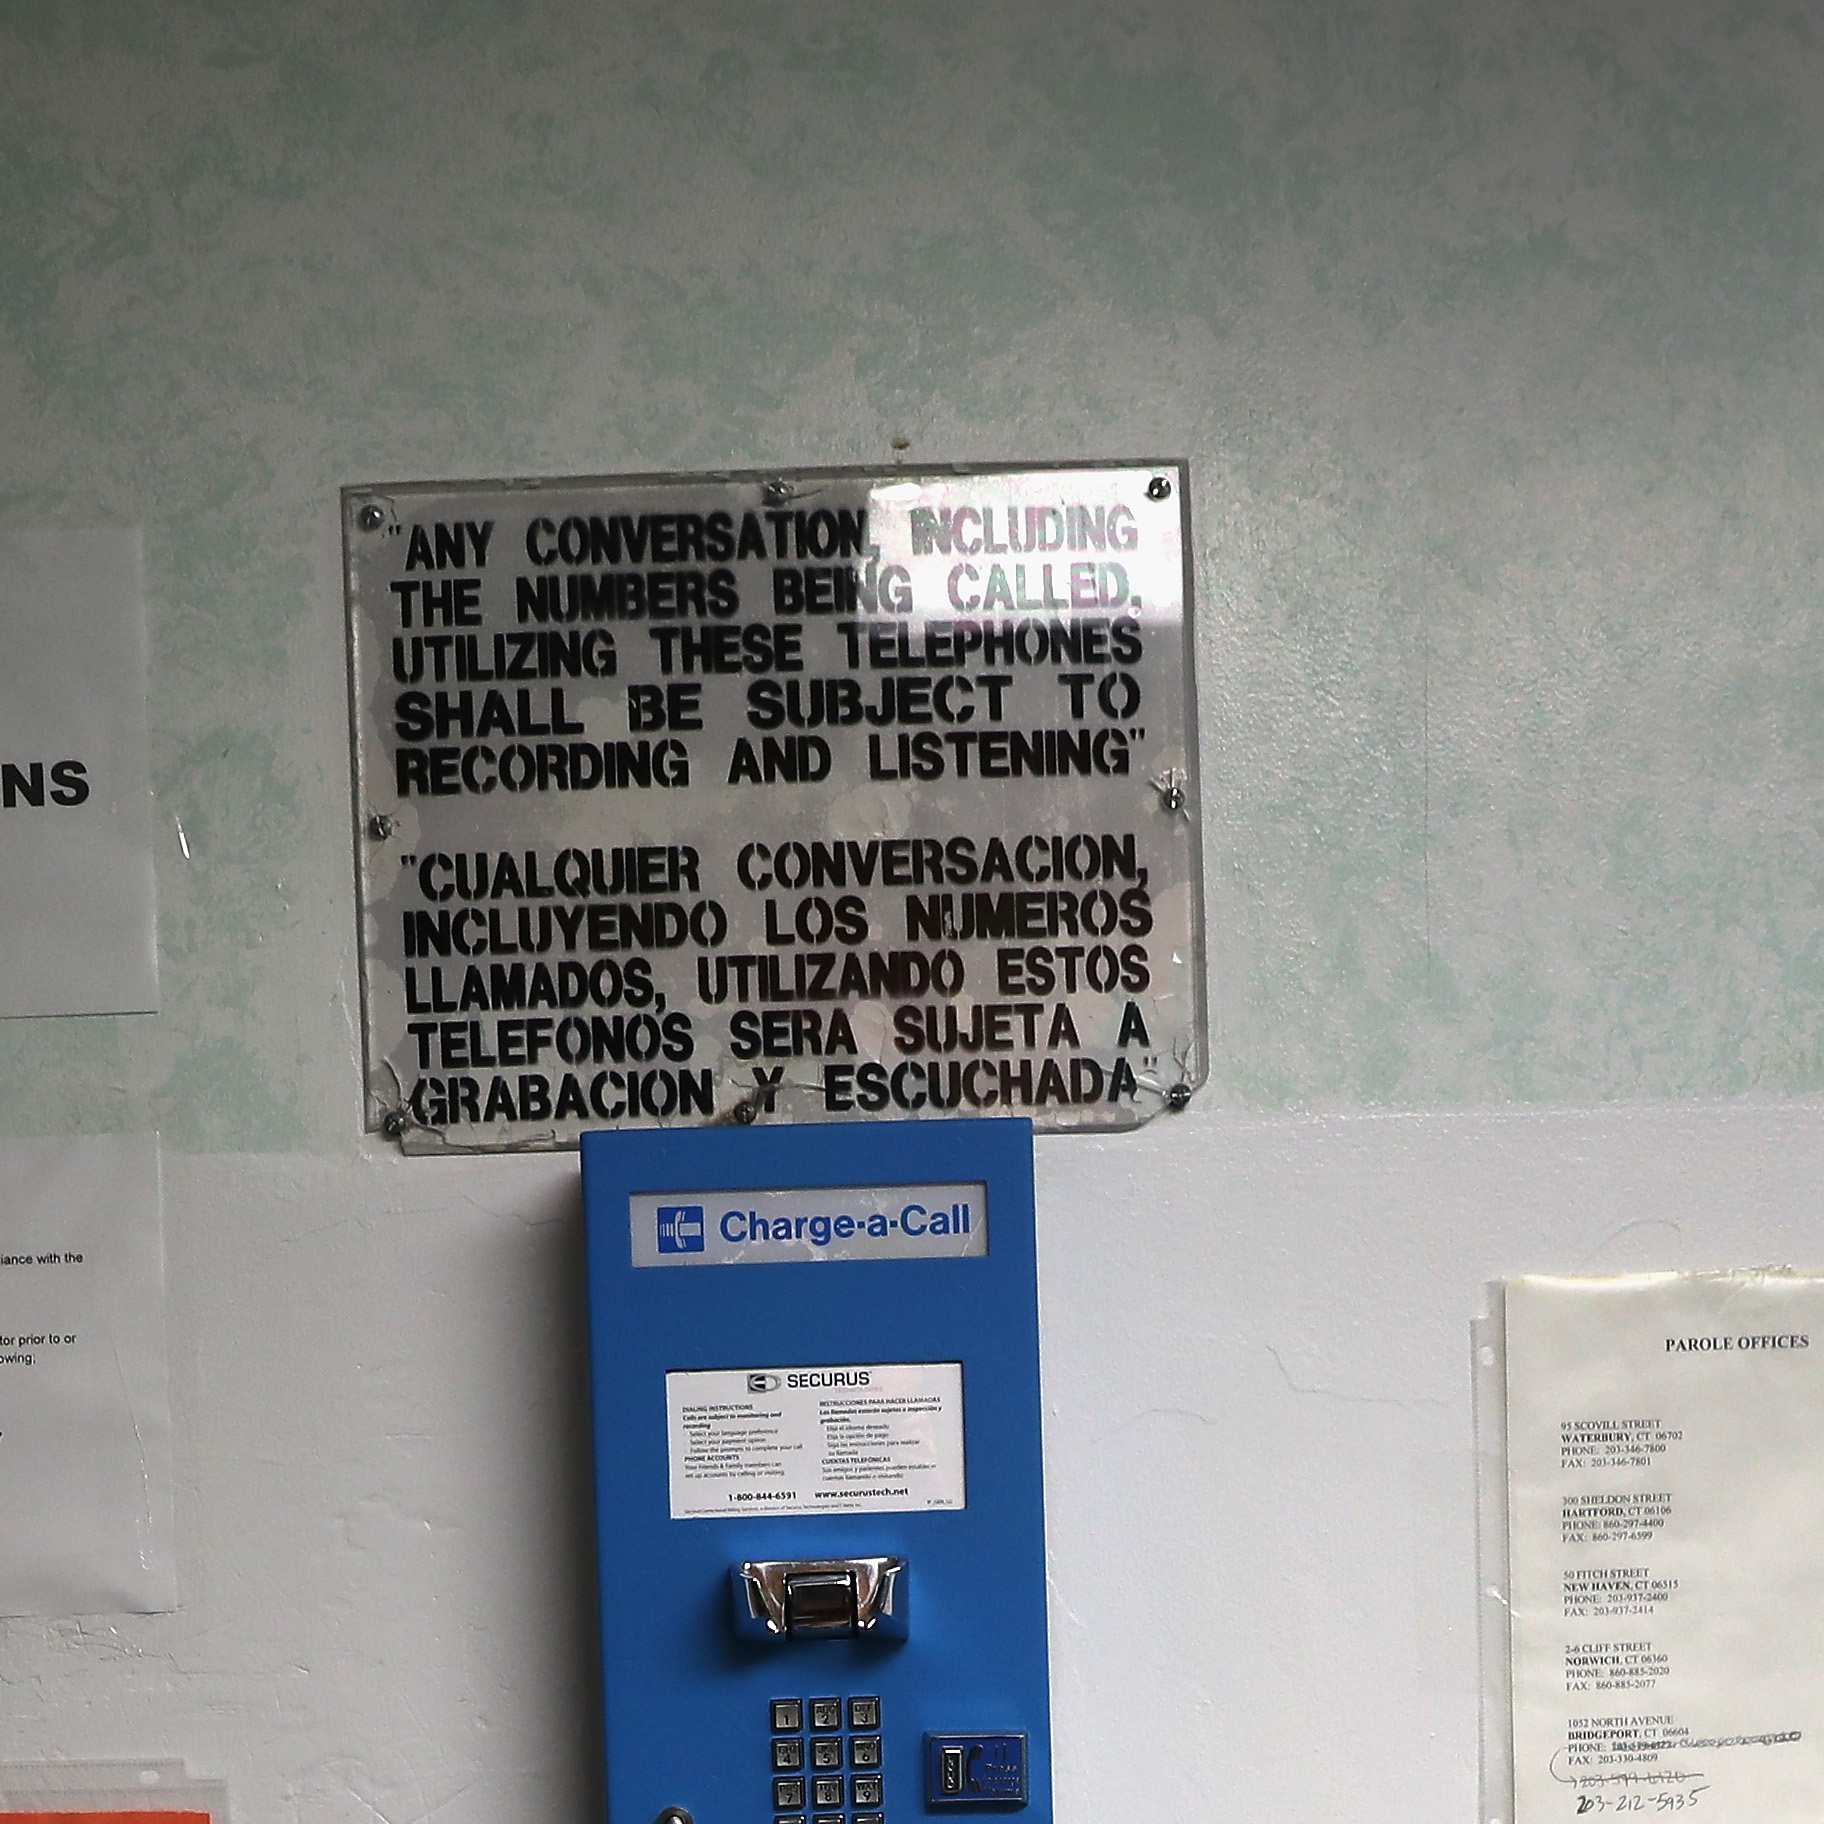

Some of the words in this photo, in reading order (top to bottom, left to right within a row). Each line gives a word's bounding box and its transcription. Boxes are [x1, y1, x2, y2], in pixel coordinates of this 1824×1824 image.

[388, 521, 494, 572] "ANY
[527, 508, 880, 568] CONVERSATION,
[907, 503, 1138, 556] INCLUDING
[390, 578, 482, 628] THE
[516, 568, 740, 624] NUMBERS
[774, 563, 913, 614] BEING
[947, 562, 1142, 614] CALLED,
[392, 628, 617, 684] UTILIZING
[649, 623, 804, 675] THESE
[839, 618, 1143, 670] TELEPHONES
[394, 687, 584, 742] SHALL
[628, 683, 703, 733] BE
[747, 675, 1013, 730] SUBJECT
[1058, 671, 1141, 720] TO
[395, 738, 689, 798] RECORDING
[728, 735, 831, 785] AND
[868, 725, 1145, 781] LISTENING"
[36, 1253, 61, 1264] with
[64, 1252, 83, 1263] the
[1666, 1337, 1733, 1352] PAROLE
[1737, 1335, 1809, 1350] OFFICES
[787, 1371, 872, 1388] SECURUS
[728, 1490, 798, 1503] 1-800-844-6591
[814, 1488, 908, 1498] www.securustech.net
